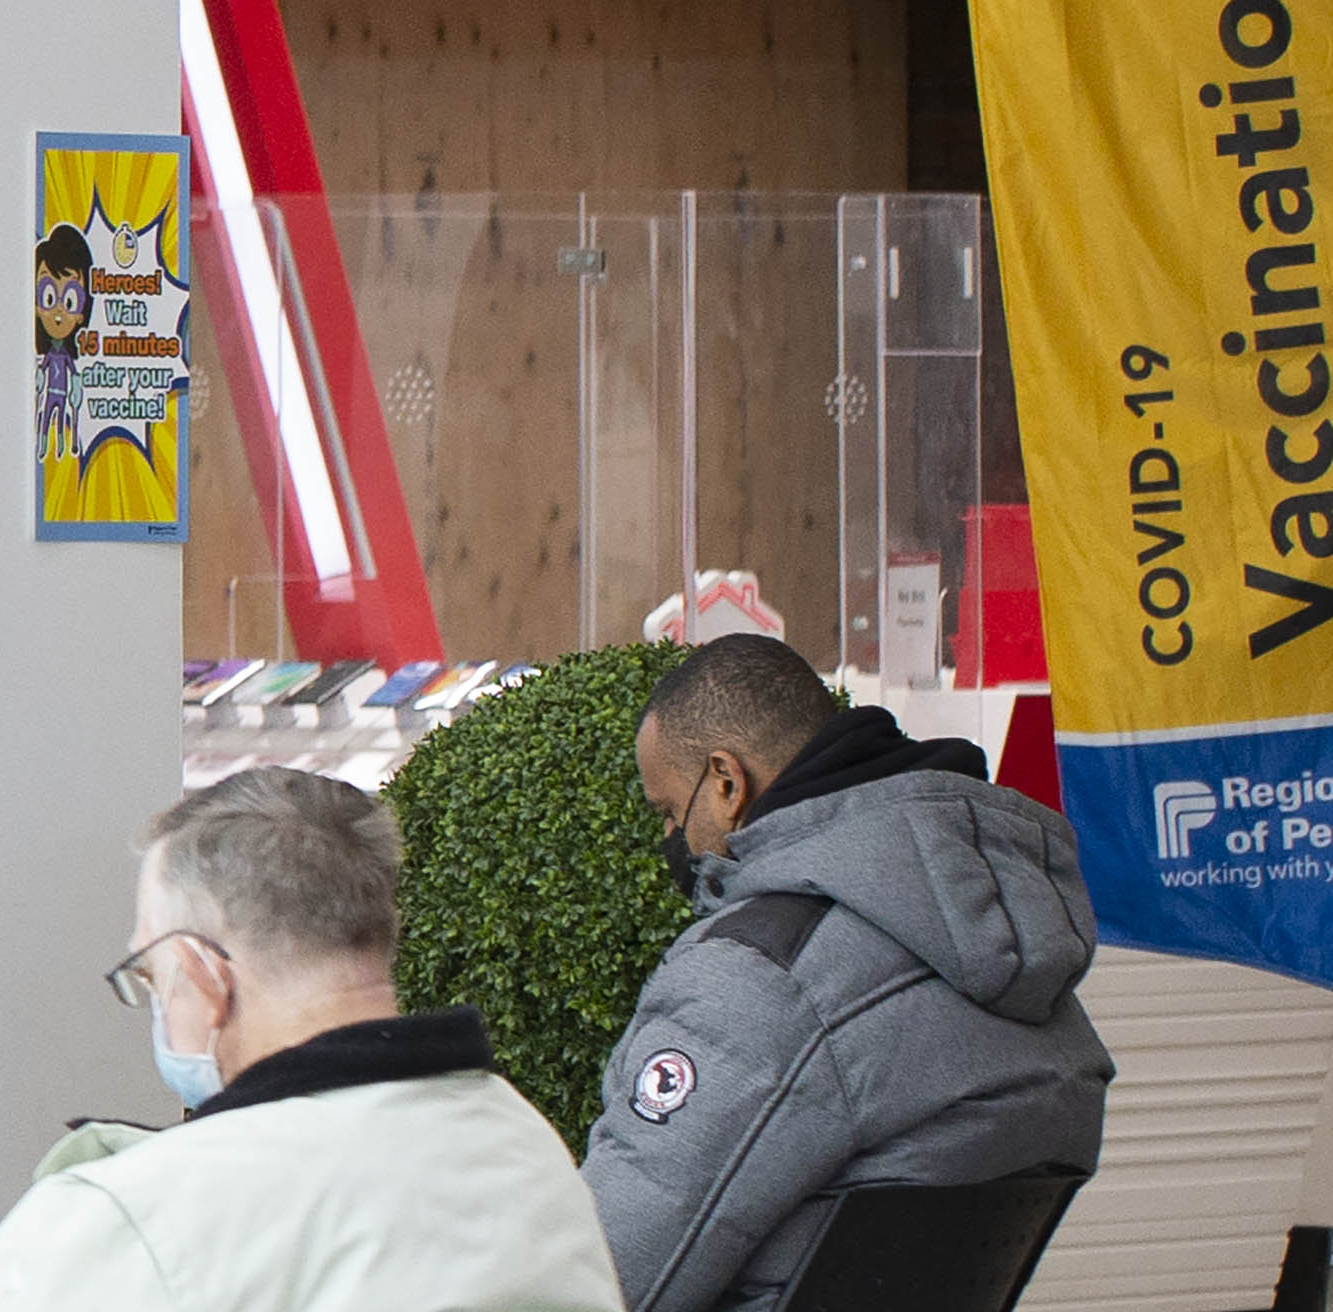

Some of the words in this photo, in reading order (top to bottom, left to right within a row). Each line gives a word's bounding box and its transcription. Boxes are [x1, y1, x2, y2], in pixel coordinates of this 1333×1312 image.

[91, 268, 162, 295] Heroes!
[104, 299, 148, 326] Wait
[77, 330, 99, 356] 15
[102, 330, 181, 358] minutes
[82, 361, 126, 388] after
[127, 368, 174, 395] your
[87, 392, 165, 420] vaccine!
[1120, 344, 1193, 667] COVID-19
[1221, 771, 1333, 813] Regio
[1225, 820, 1270, 854] of
[1282, 817, 1333, 850] Pe
[1160, 861, 1262, 888] working
[1267, 854, 1320, 880] with
